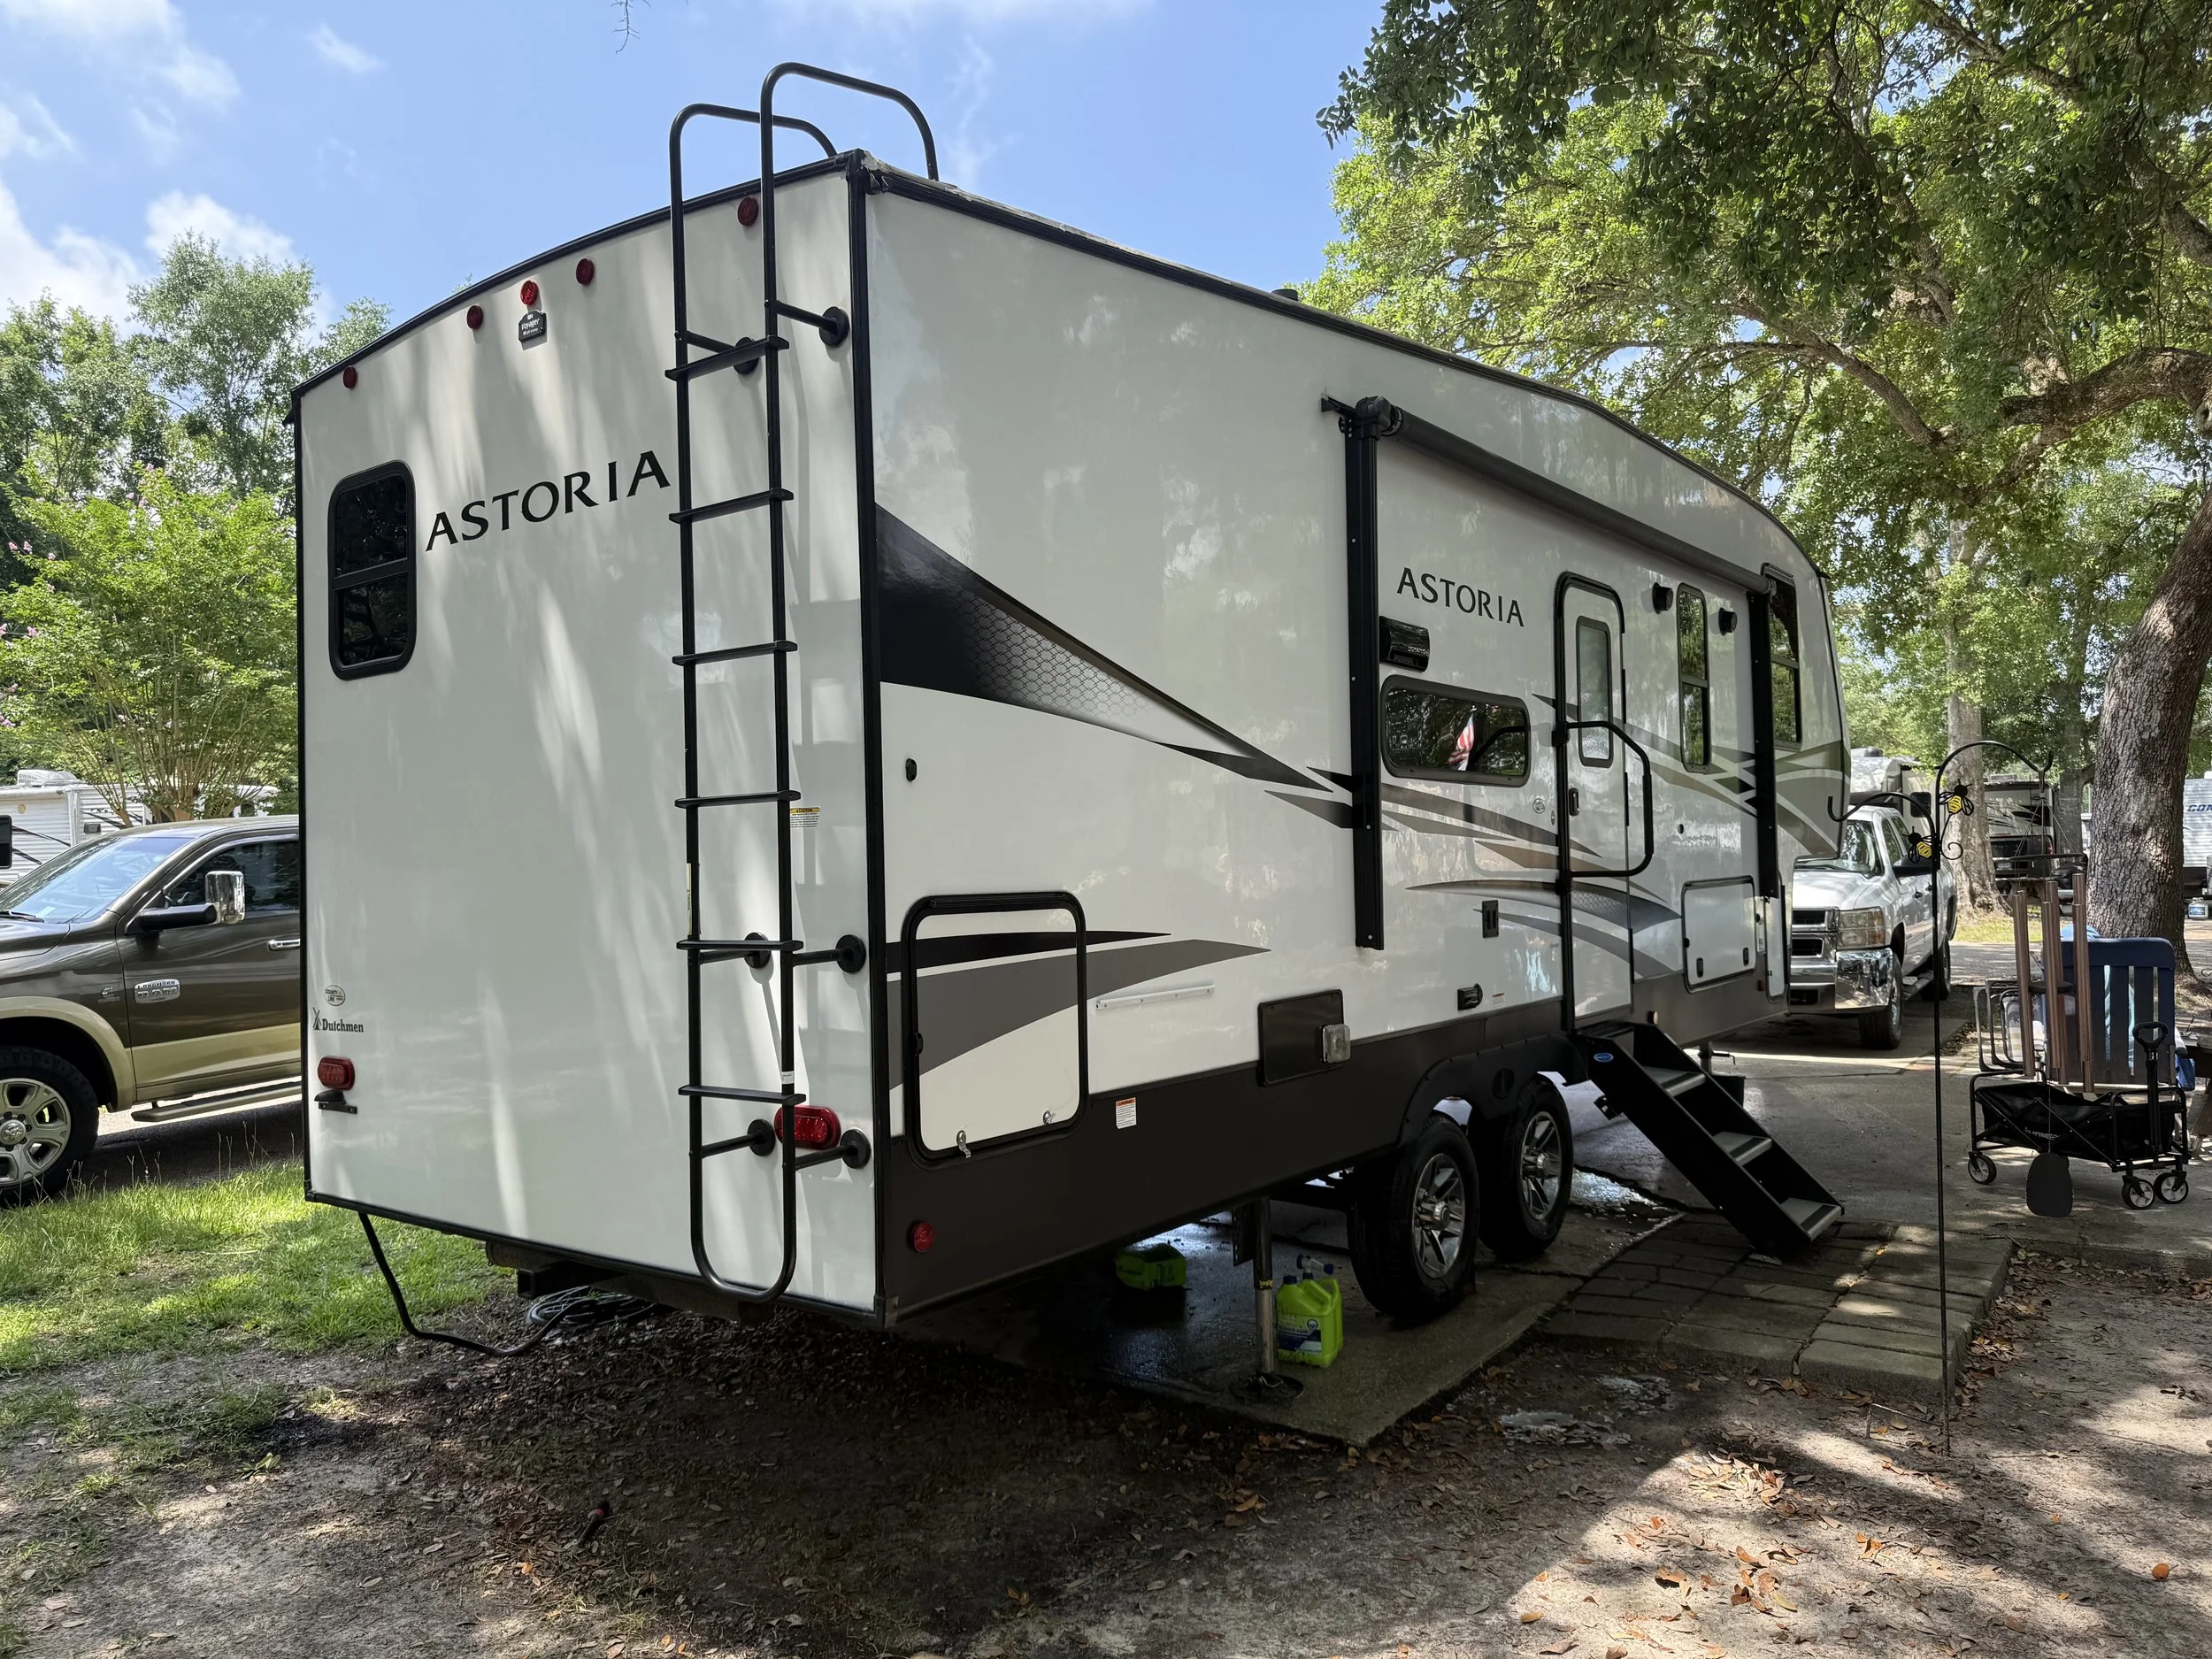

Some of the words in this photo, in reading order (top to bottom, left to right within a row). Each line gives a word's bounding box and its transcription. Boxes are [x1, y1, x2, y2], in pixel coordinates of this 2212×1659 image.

[425, 449, 672, 552] ASTORIA
[1396, 566, 1525, 627] ASTORIA
[322, 1018, 364, 1033] Dutchmen
